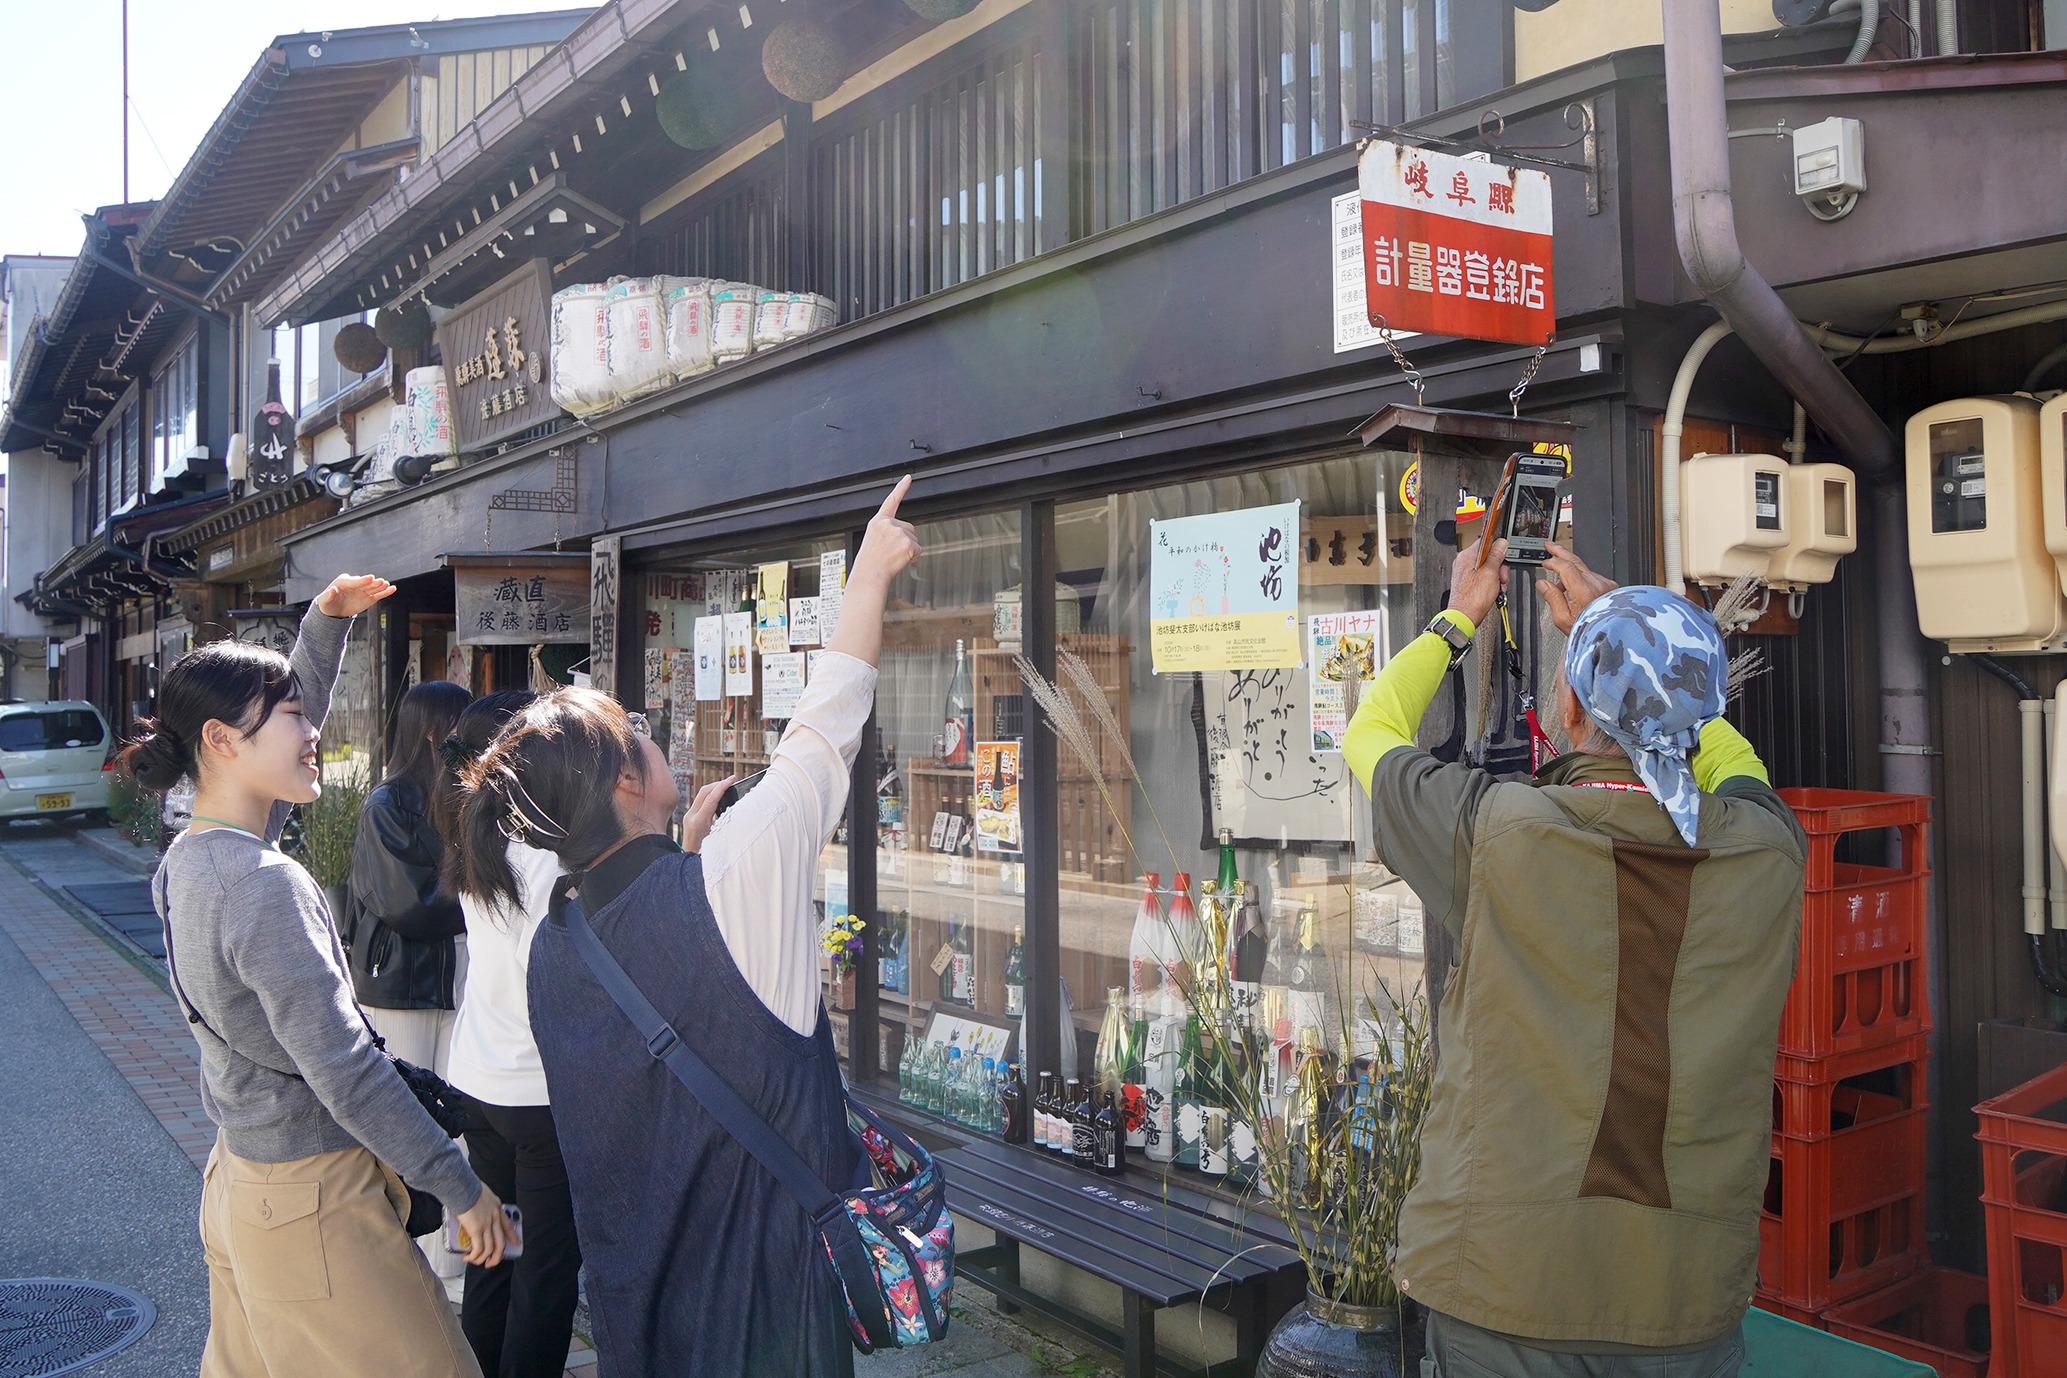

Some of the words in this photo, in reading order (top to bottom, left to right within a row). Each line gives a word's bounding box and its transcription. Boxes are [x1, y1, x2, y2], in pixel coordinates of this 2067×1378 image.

[1258, 526, 1283, 602] 池坊
[493, 574, 547, 603] 蔵直
[475, 611, 571, 633] 後藤酒店
[1320, 614, 1376, 635] 古川ヤナ
